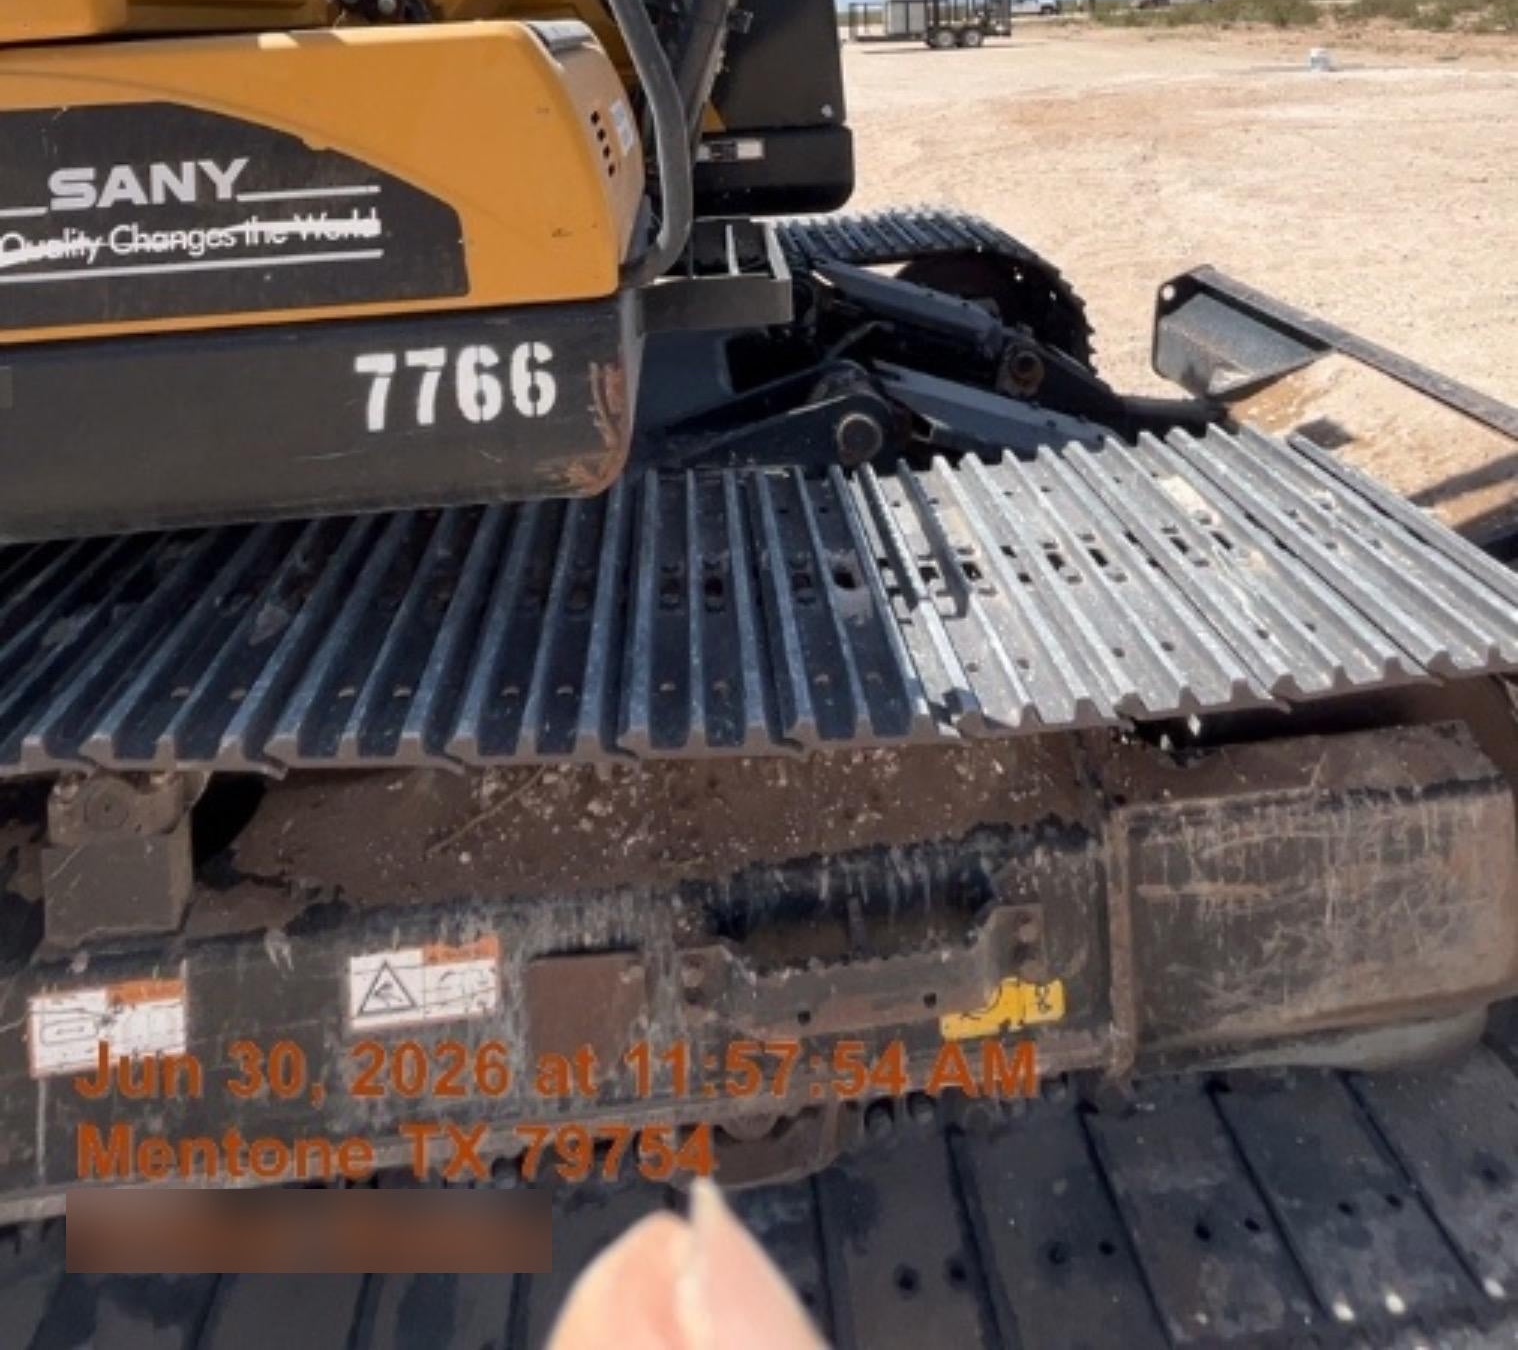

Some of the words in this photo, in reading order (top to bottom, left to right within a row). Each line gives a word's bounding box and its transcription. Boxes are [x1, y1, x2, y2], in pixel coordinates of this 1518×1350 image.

[48, 157, 249, 211] SANY
[110, 222, 237, 256] Changes
[354, 341, 557, 432] 7766
